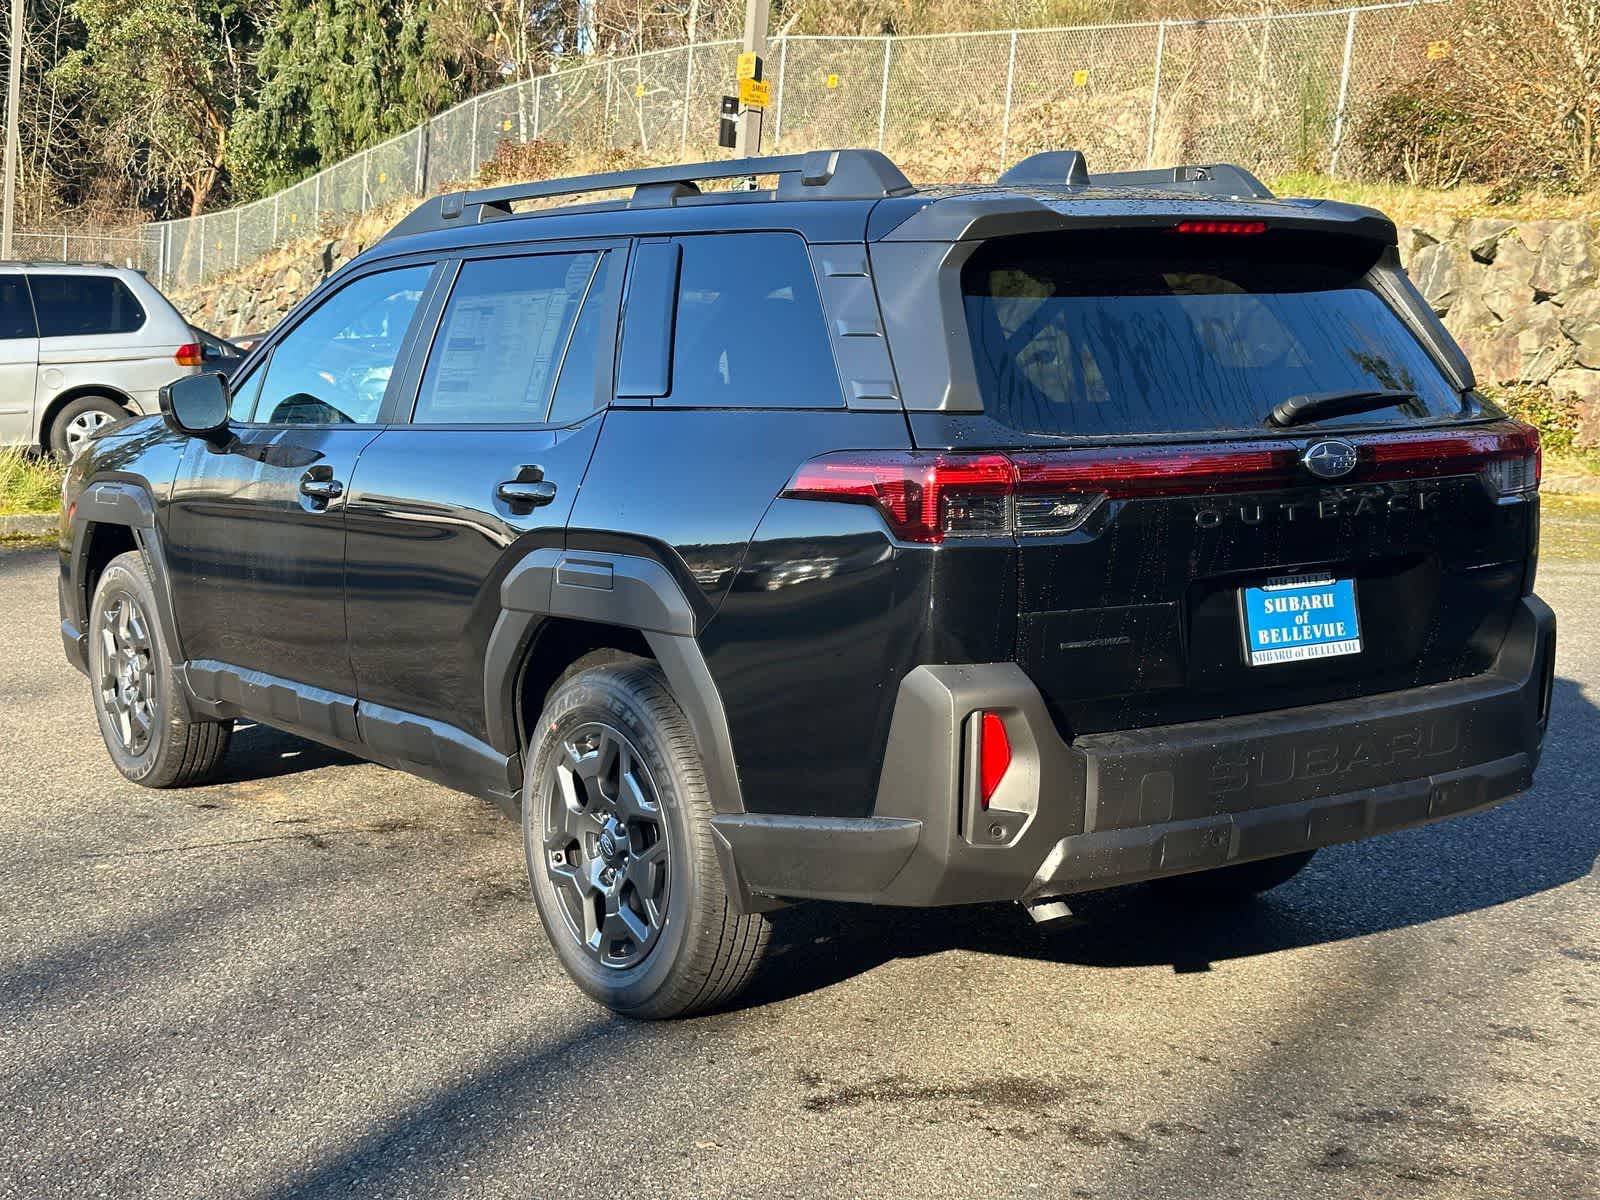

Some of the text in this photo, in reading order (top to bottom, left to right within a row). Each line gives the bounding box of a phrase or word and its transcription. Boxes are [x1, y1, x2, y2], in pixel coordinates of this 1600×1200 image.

[1195, 492, 1440, 528] OUTBACK
[1264, 593, 1334, 614] SUBARU
[1295, 611, 1309, 625] of
[1258, 622, 1346, 645] BELLEVUE
[1253, 641, 1358, 663] SUBARU of BELLEVUE
[1209, 721, 1460, 794] SUBARU
